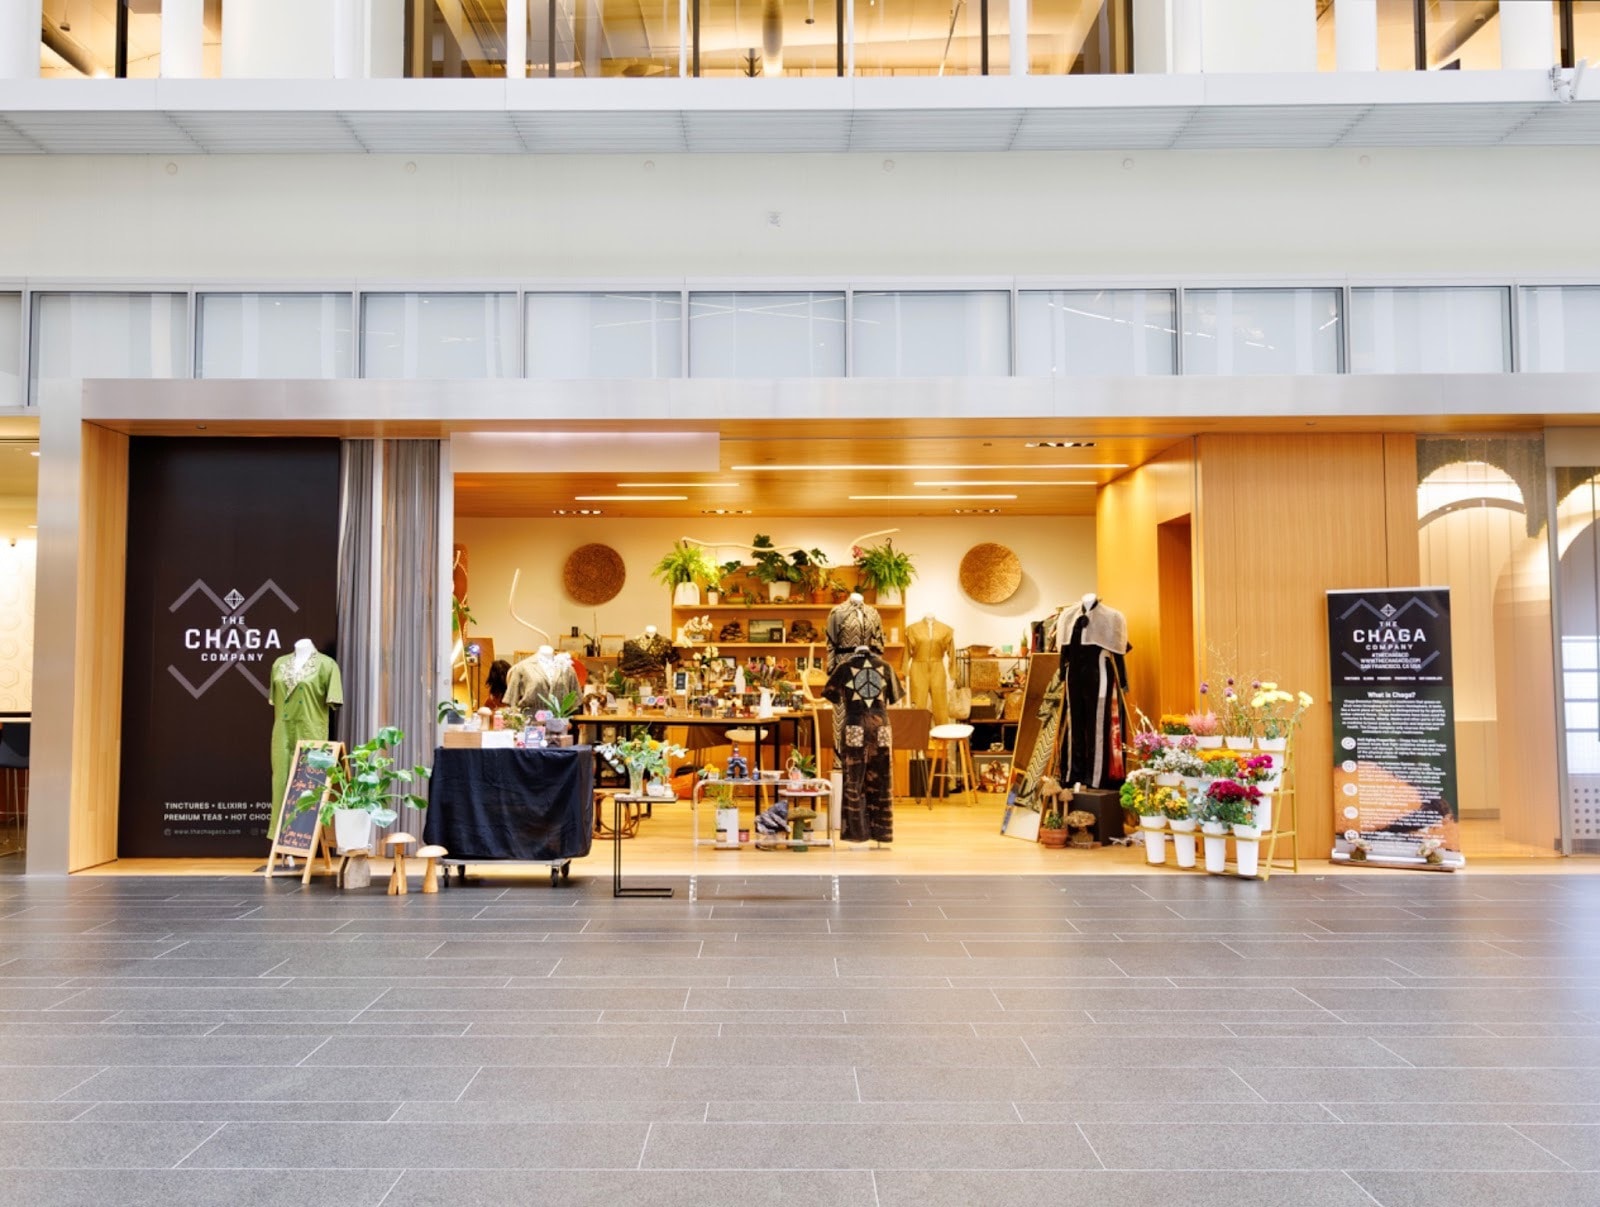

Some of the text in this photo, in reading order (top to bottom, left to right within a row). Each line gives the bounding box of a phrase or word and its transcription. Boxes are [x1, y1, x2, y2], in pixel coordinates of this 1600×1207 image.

[221, 616, 245, 625] THE
[185, 628, 281, 649] CHAGA
[1353, 628, 1426, 643] CHAGA
[1365, 643, 1413, 651] COMPANY
[201, 653, 263, 661] COMPANY
